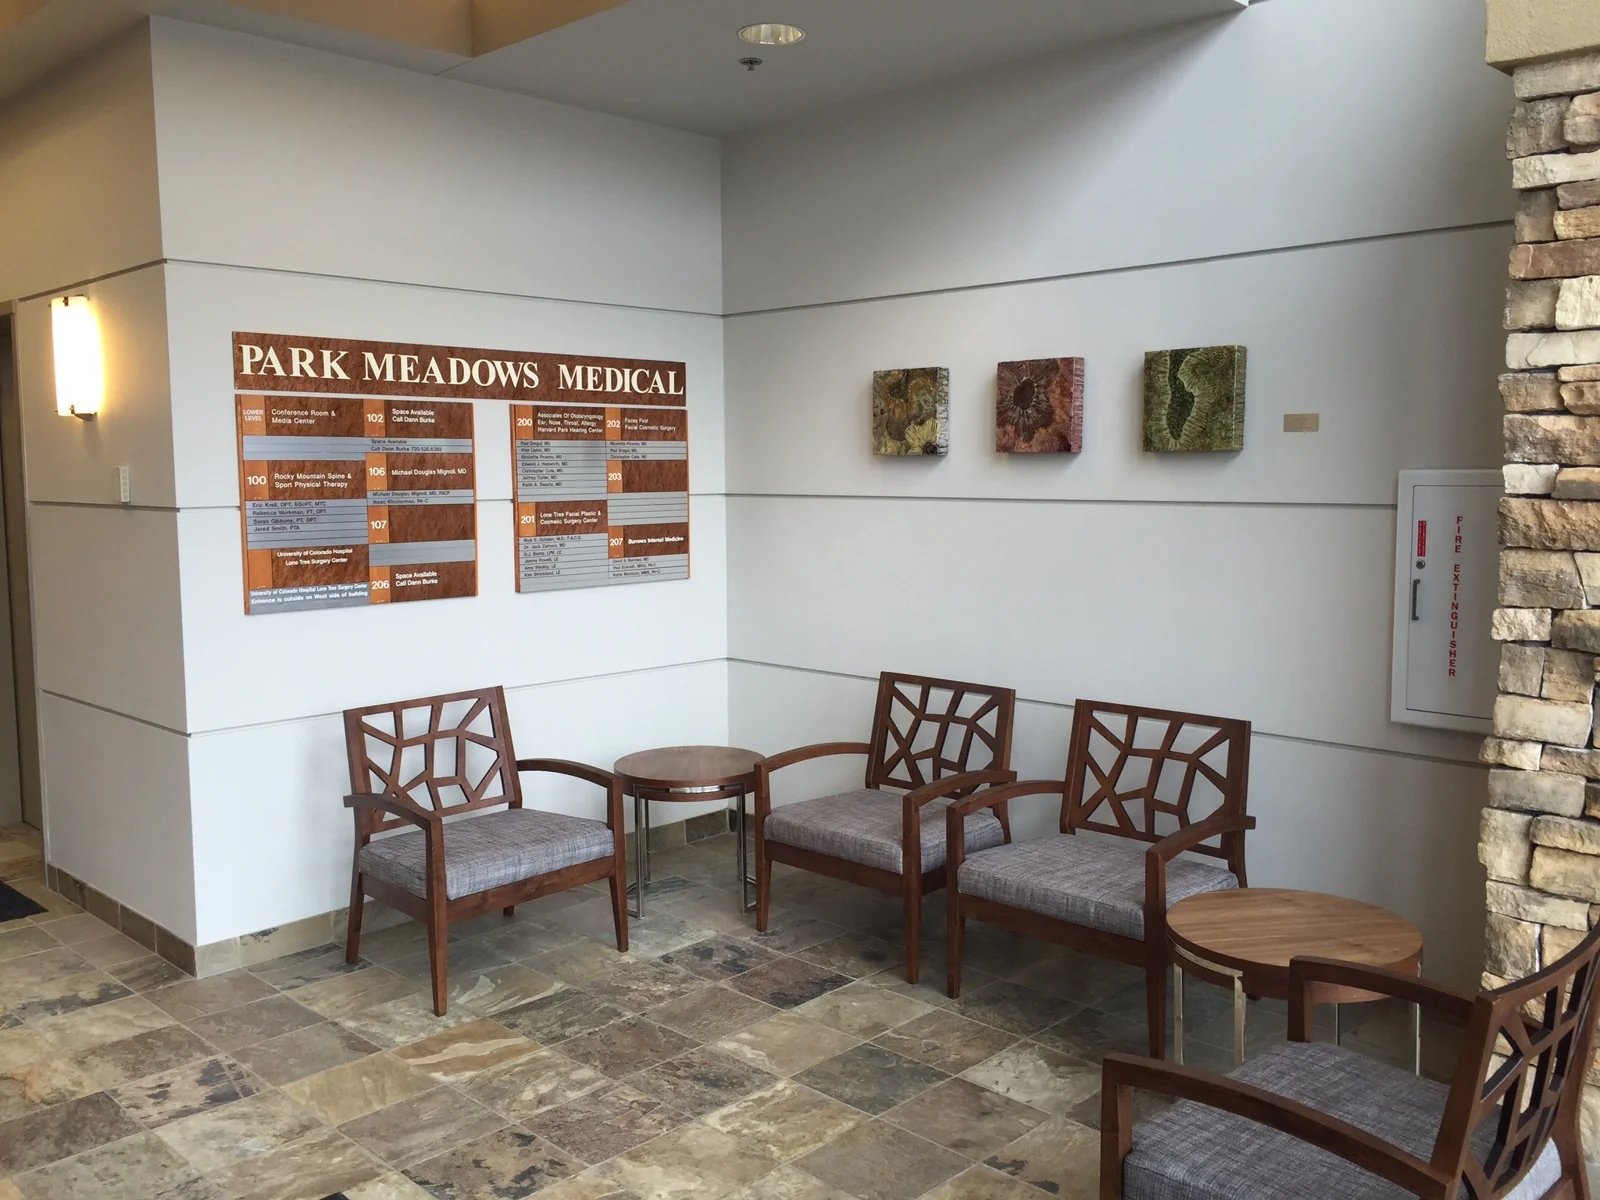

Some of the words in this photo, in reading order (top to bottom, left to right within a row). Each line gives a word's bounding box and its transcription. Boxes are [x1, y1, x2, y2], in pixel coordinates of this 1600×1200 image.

[239, 344, 351, 380] PARK
[361, 351, 540, 389] MEADOWS
[558, 363, 684, 395] MEDICAL
[367, 414, 383, 422] 102
[518, 418, 532, 426] 200
[369, 467, 386, 476] 106
[247, 476, 266, 485] 100
[371, 520, 387, 529] 107
[1454, 516, 1463, 553] FIRE
[610, 538, 623, 546] 207
[372, 581, 390, 589] 206
[1448, 564, 1460, 677] EXTINGUISHER
